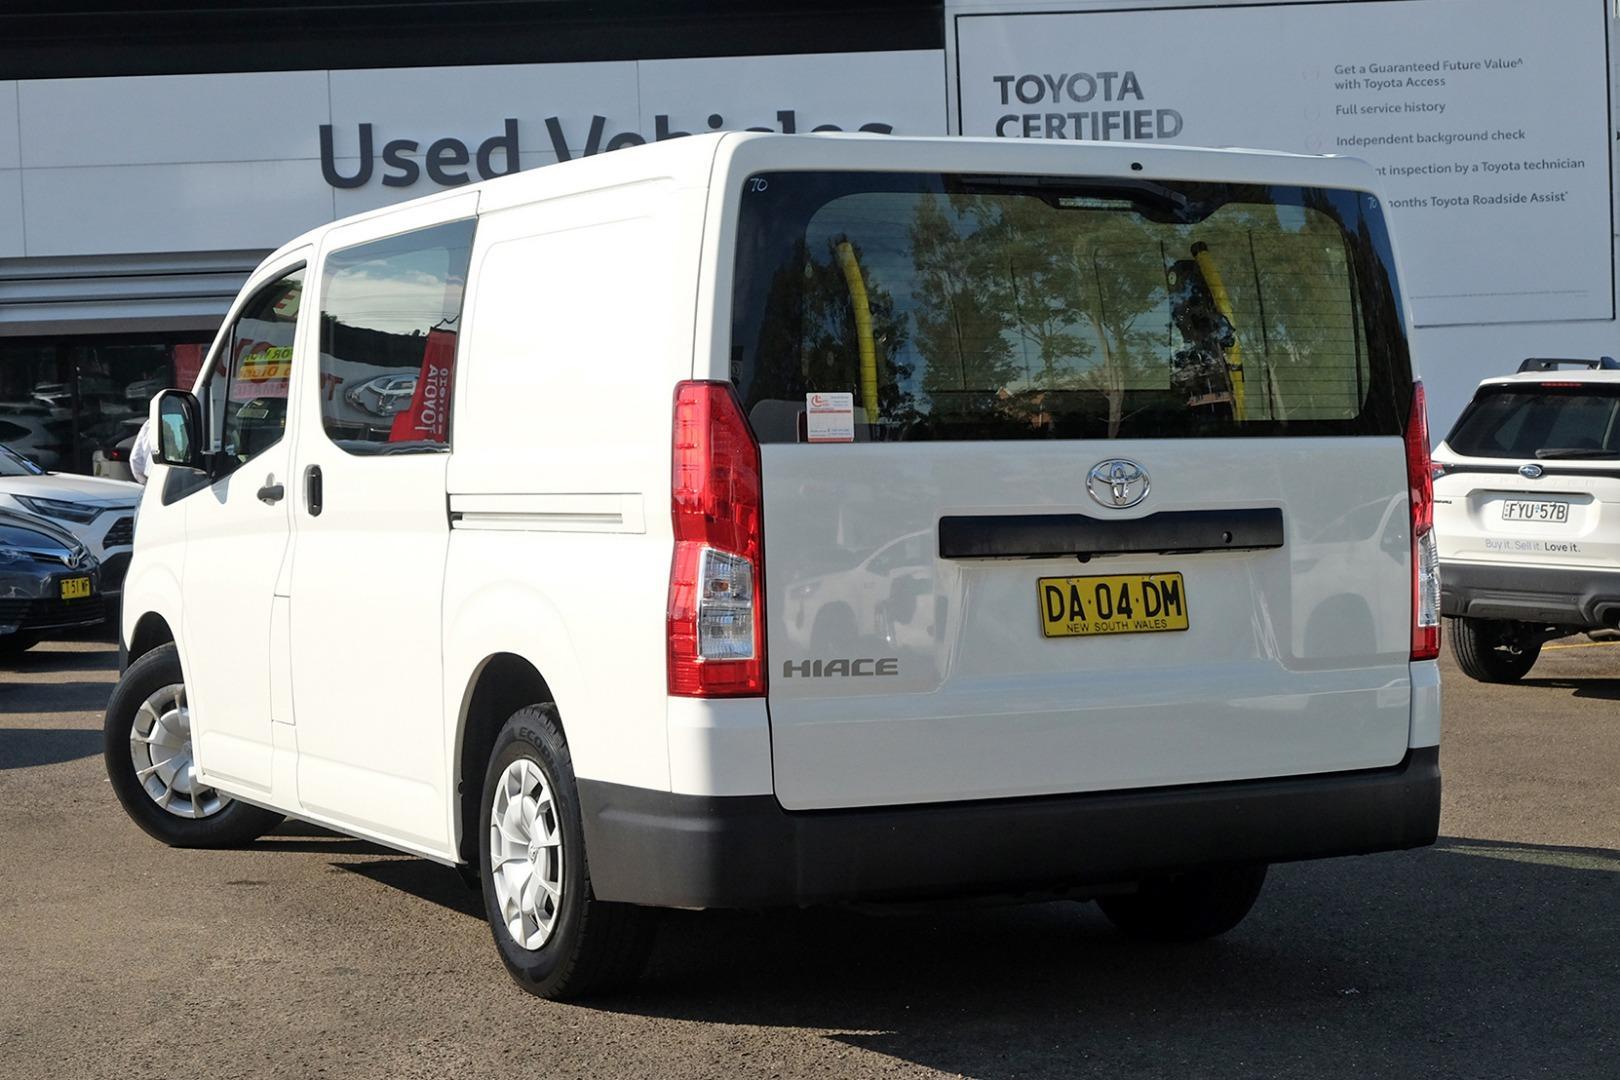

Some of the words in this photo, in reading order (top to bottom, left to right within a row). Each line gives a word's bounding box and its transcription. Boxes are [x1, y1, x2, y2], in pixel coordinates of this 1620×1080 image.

[1334, 63, 1356, 75] Get
[1359, 66, 1366, 74] a
[1369, 60, 1440, 74] Guaranteed
[1443, 60, 1482, 71] Future
[993, 71, 1145, 105] TOYOTA
[1334, 78, 1361, 90] with
[1364, 78, 1403, 91] Toyota
[1406, 77, 1446, 88] Access
[1335, 104, 1358, 115] Full
[1360, 103, 1402, 114] service
[1404, 102, 1446, 114] history
[995, 109, 1184, 141] CERTIFIED
[1336, 133, 1414, 147] Independent
[1416, 131, 1488, 144] background
[1491, 129, 1526, 141] check
[318, 117, 521, 189] Used
[1389, 164, 1452, 177] inspection
[1455, 162, 1469, 175] by
[1472, 164, 1479, 173] a
[1482, 161, 1521, 174] Toyota
[1523, 158, 1585, 171] technician
[1430, 196, 1470, 209] Toyota
[1473, 193, 1527, 206] Roadside
[1486, 539, 1503, 550] Buy
[1544, 541, 1568, 552] Love
[1570, 542, 1581, 553] it.
[1067, 623, 1089, 633] NEW
[1094, 621, 1128, 632] SOUTH
[1134, 619, 1168, 630] WALES
[783, 658, 898, 678] HIACE
